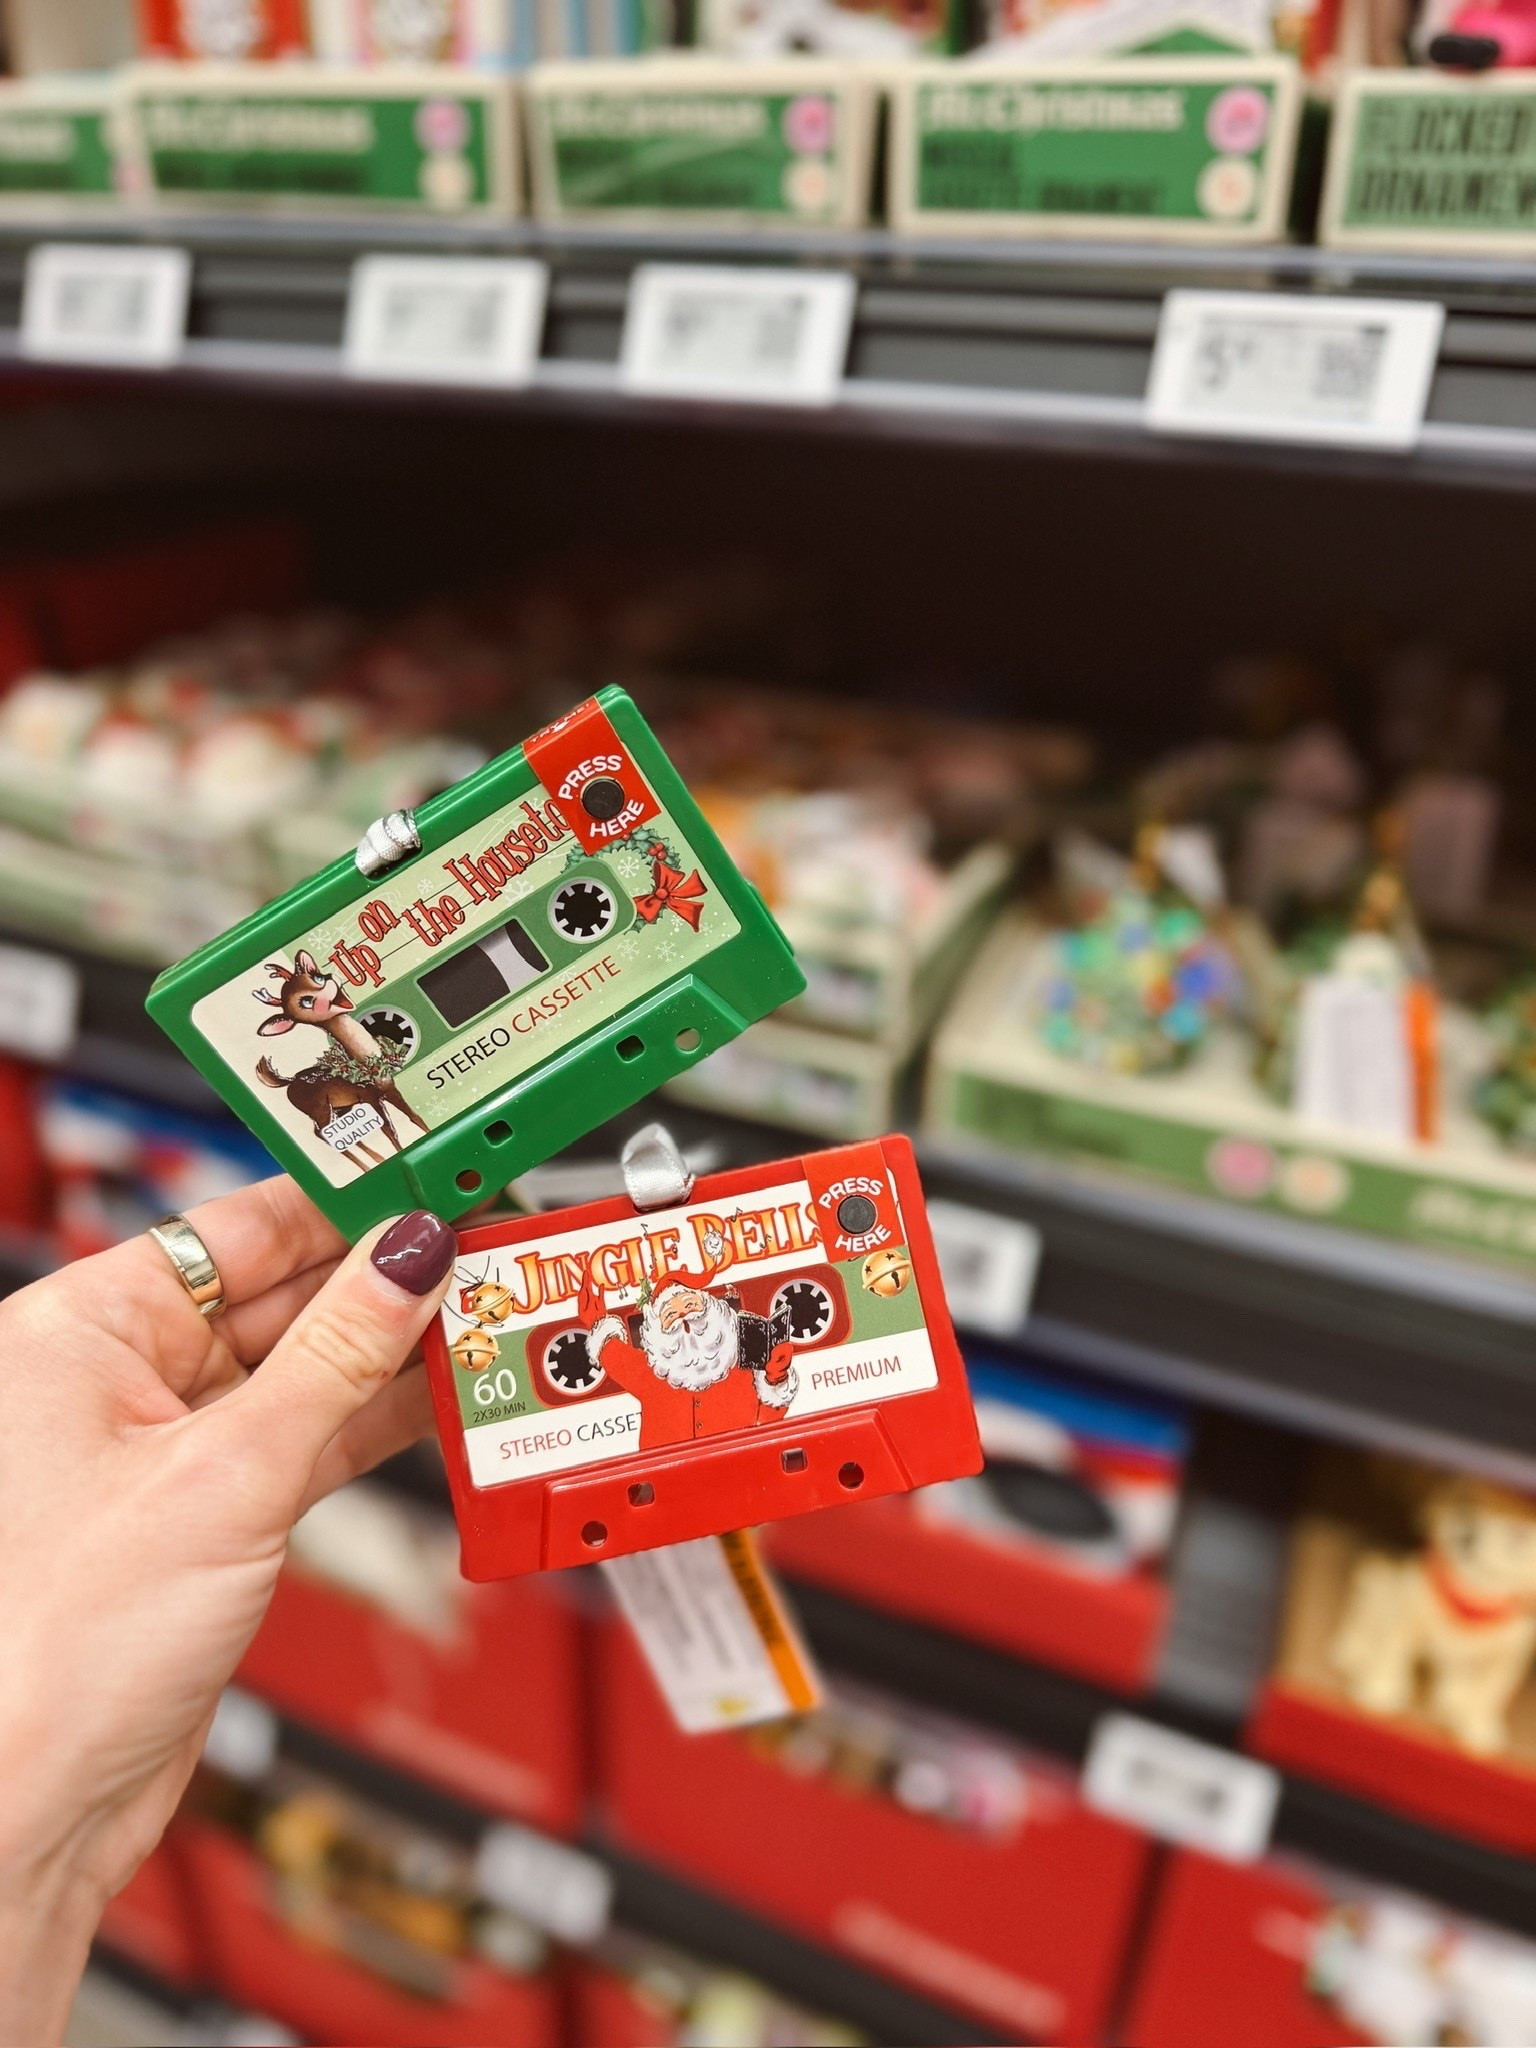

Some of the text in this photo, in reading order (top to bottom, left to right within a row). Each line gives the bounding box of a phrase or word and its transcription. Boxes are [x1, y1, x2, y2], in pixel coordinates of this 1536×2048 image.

[558, 754, 623, 800] PRESS
[589, 799, 645, 838] HERE
[329, 939, 385, 988] Up
[357, 899, 400, 943] on
[401, 894, 466, 948] the
[426, 955, 622, 1090] STEREO CASSETTE
[323, 1107, 366, 1139] STUDIO
[334, 1115, 382, 1151] QUALITY
[818, 1176, 884, 1210] PRESS
[835, 1223, 892, 1253] HERE
[473, 1368, 517, 1406] 60
[811, 1355, 903, 1391] PREMIUM
[473, 1401, 527, 1423] 2X30 MIN
[500, 1429, 572, 1460] STEREO
